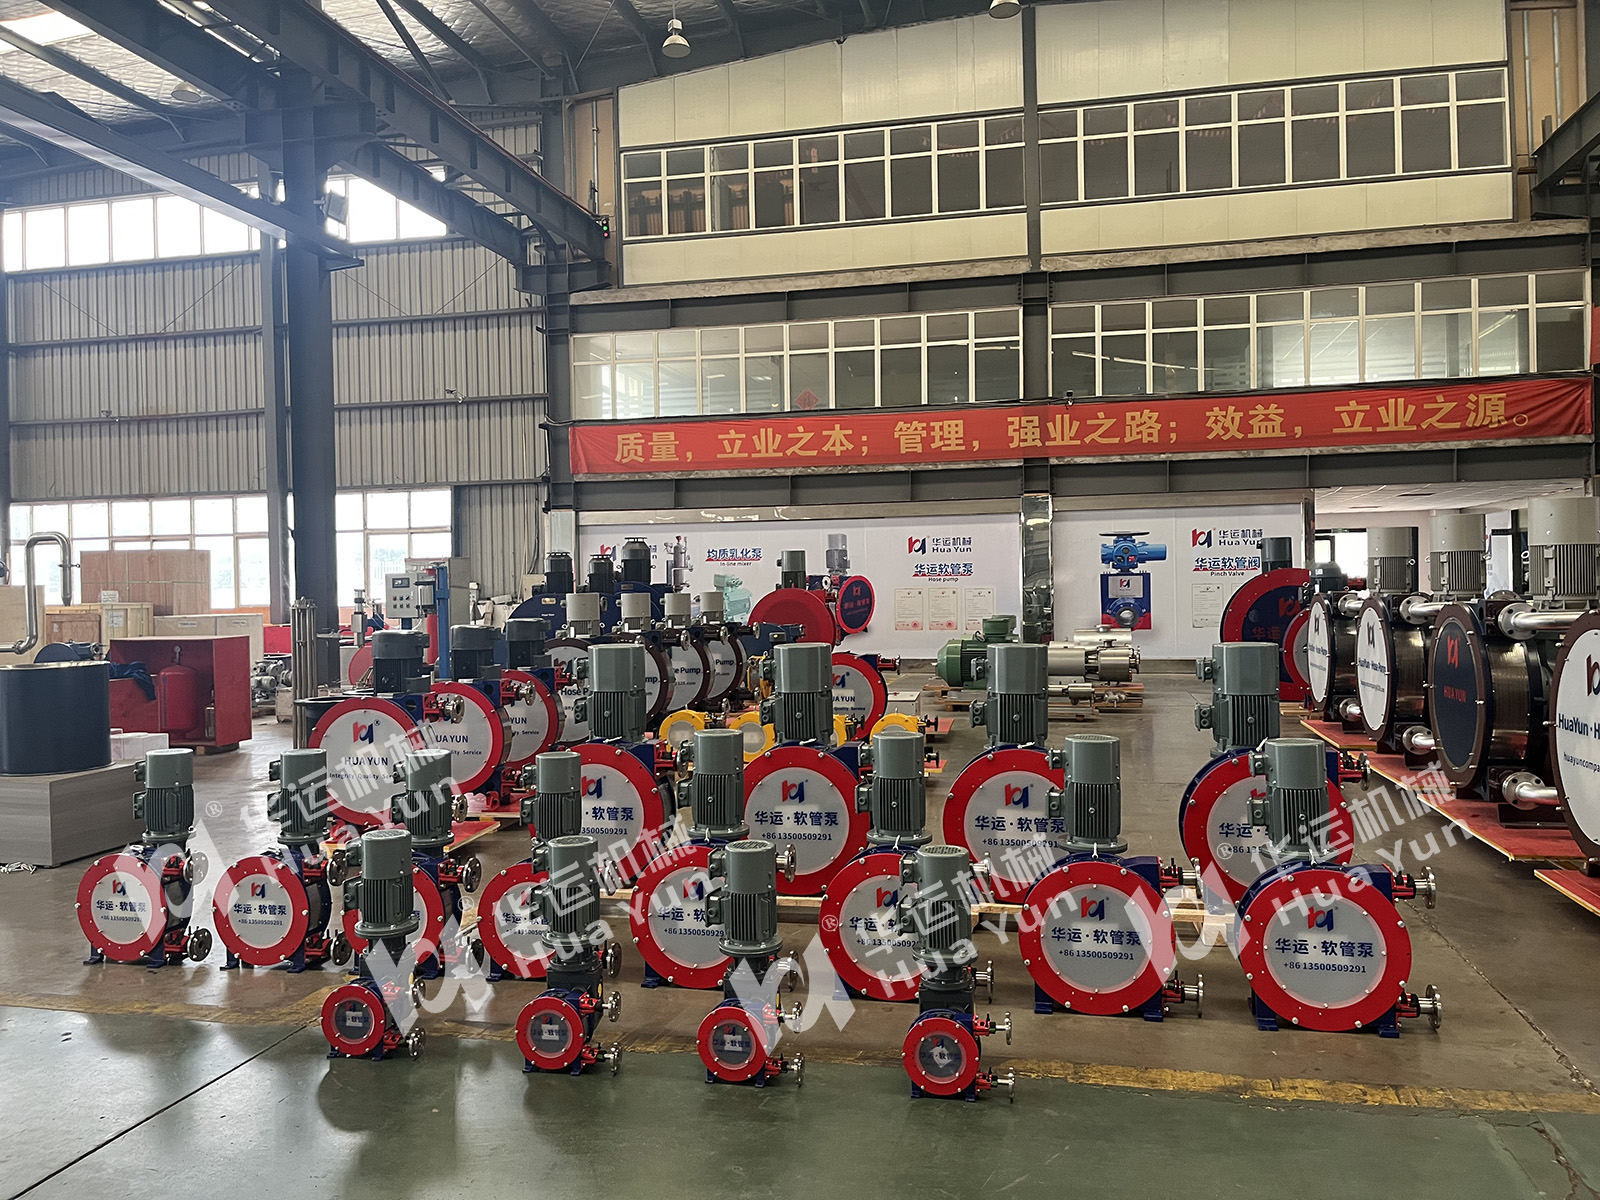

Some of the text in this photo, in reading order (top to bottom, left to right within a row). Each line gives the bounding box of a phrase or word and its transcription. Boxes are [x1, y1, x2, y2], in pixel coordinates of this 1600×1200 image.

[1219, 529, 1263, 539] 华运机械
[932, 537, 972, 546] 华运机械
[707, 548, 762, 559] 均质乳化泵
[1195, 556, 1260, 569] 华运软管阀
[914, 563, 974, 574] 华运软管泵
[561, 688, 581, 696] Hose
[581, 827, 628, 835] 3500509291
[778, 832, 832, 840] 13500509291
[982, 838, 998, 846] +86
[678, 928, 724, 937] 1350050929
[1059, 949, 1134, 960] +86 13500509291
[1302, 962, 1366, 973] 13500509291
